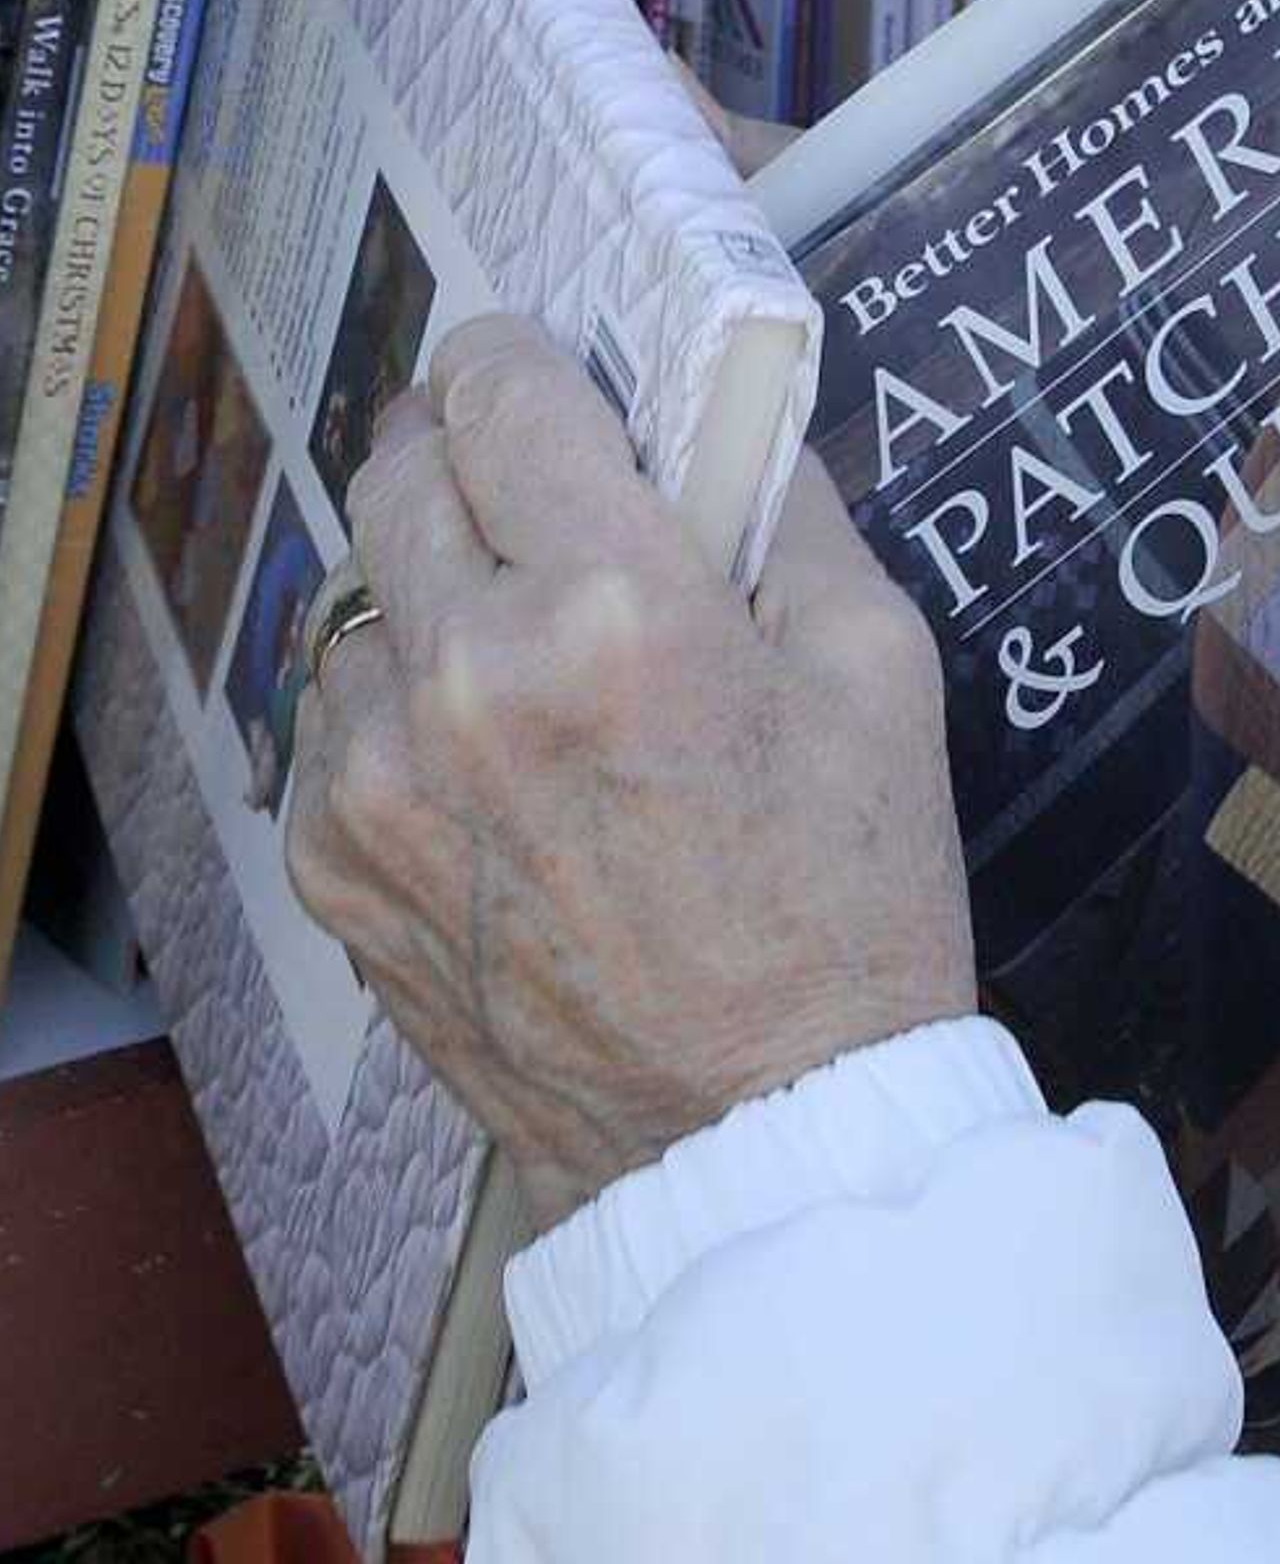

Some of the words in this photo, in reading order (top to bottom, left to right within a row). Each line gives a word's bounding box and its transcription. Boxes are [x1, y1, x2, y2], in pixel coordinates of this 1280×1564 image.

[22, 15, 64, 96] Walk
[104, 45, 132, 71] 12
[10, 109, 46, 174] into
[840, 183, 1023, 337] Better
[1023, 30, 1225, 202] Homes
[44, 215, 99, 399] CHRISTMAS
[997, 623, 1106, 730] &
